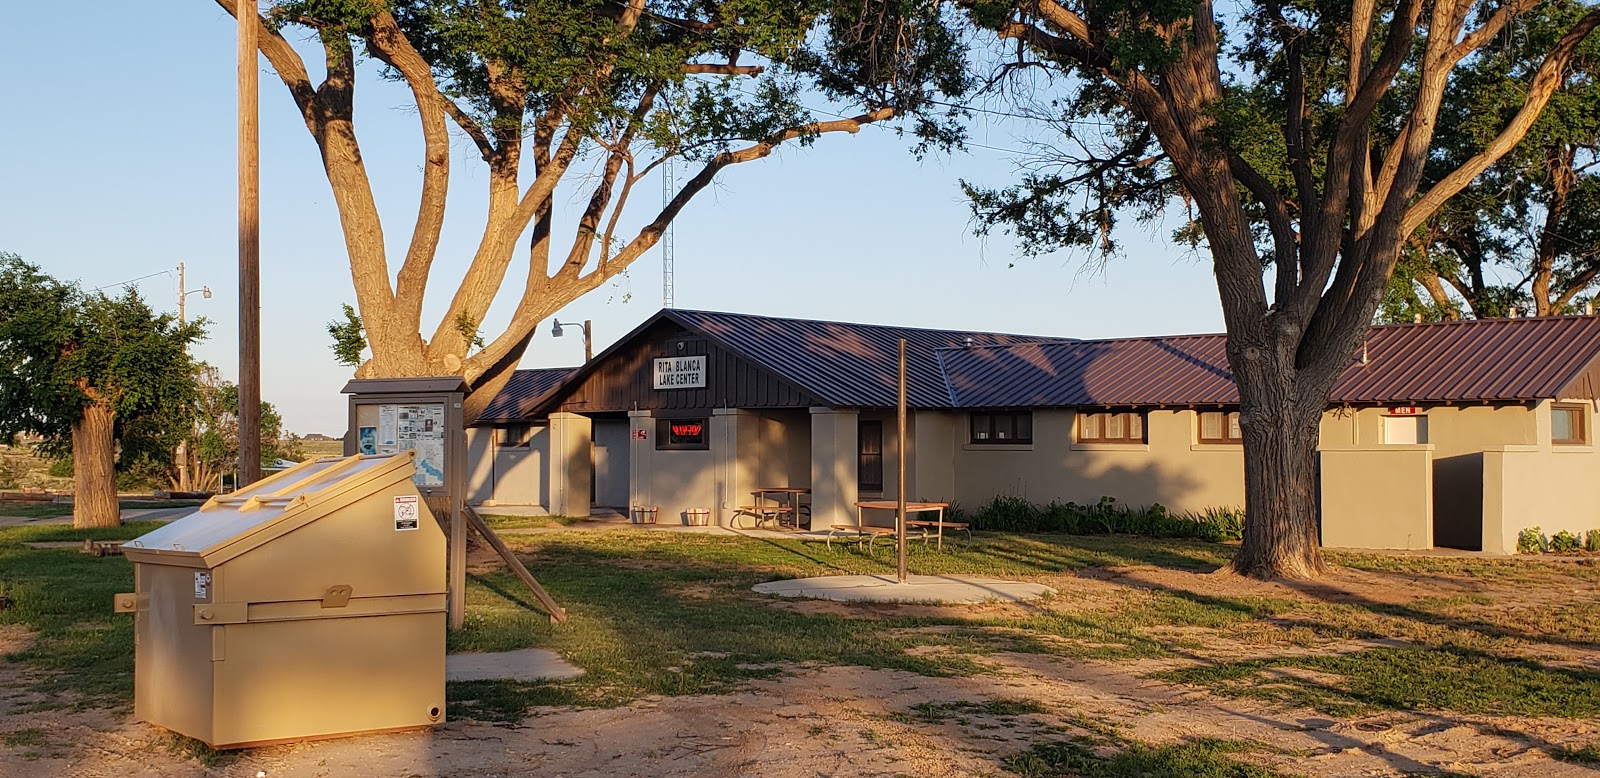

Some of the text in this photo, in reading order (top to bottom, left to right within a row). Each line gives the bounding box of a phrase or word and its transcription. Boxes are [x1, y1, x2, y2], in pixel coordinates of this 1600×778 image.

[659, 360, 700, 372] RITA BLANCA
[659, 373, 699, 385] LAKE CENTER
